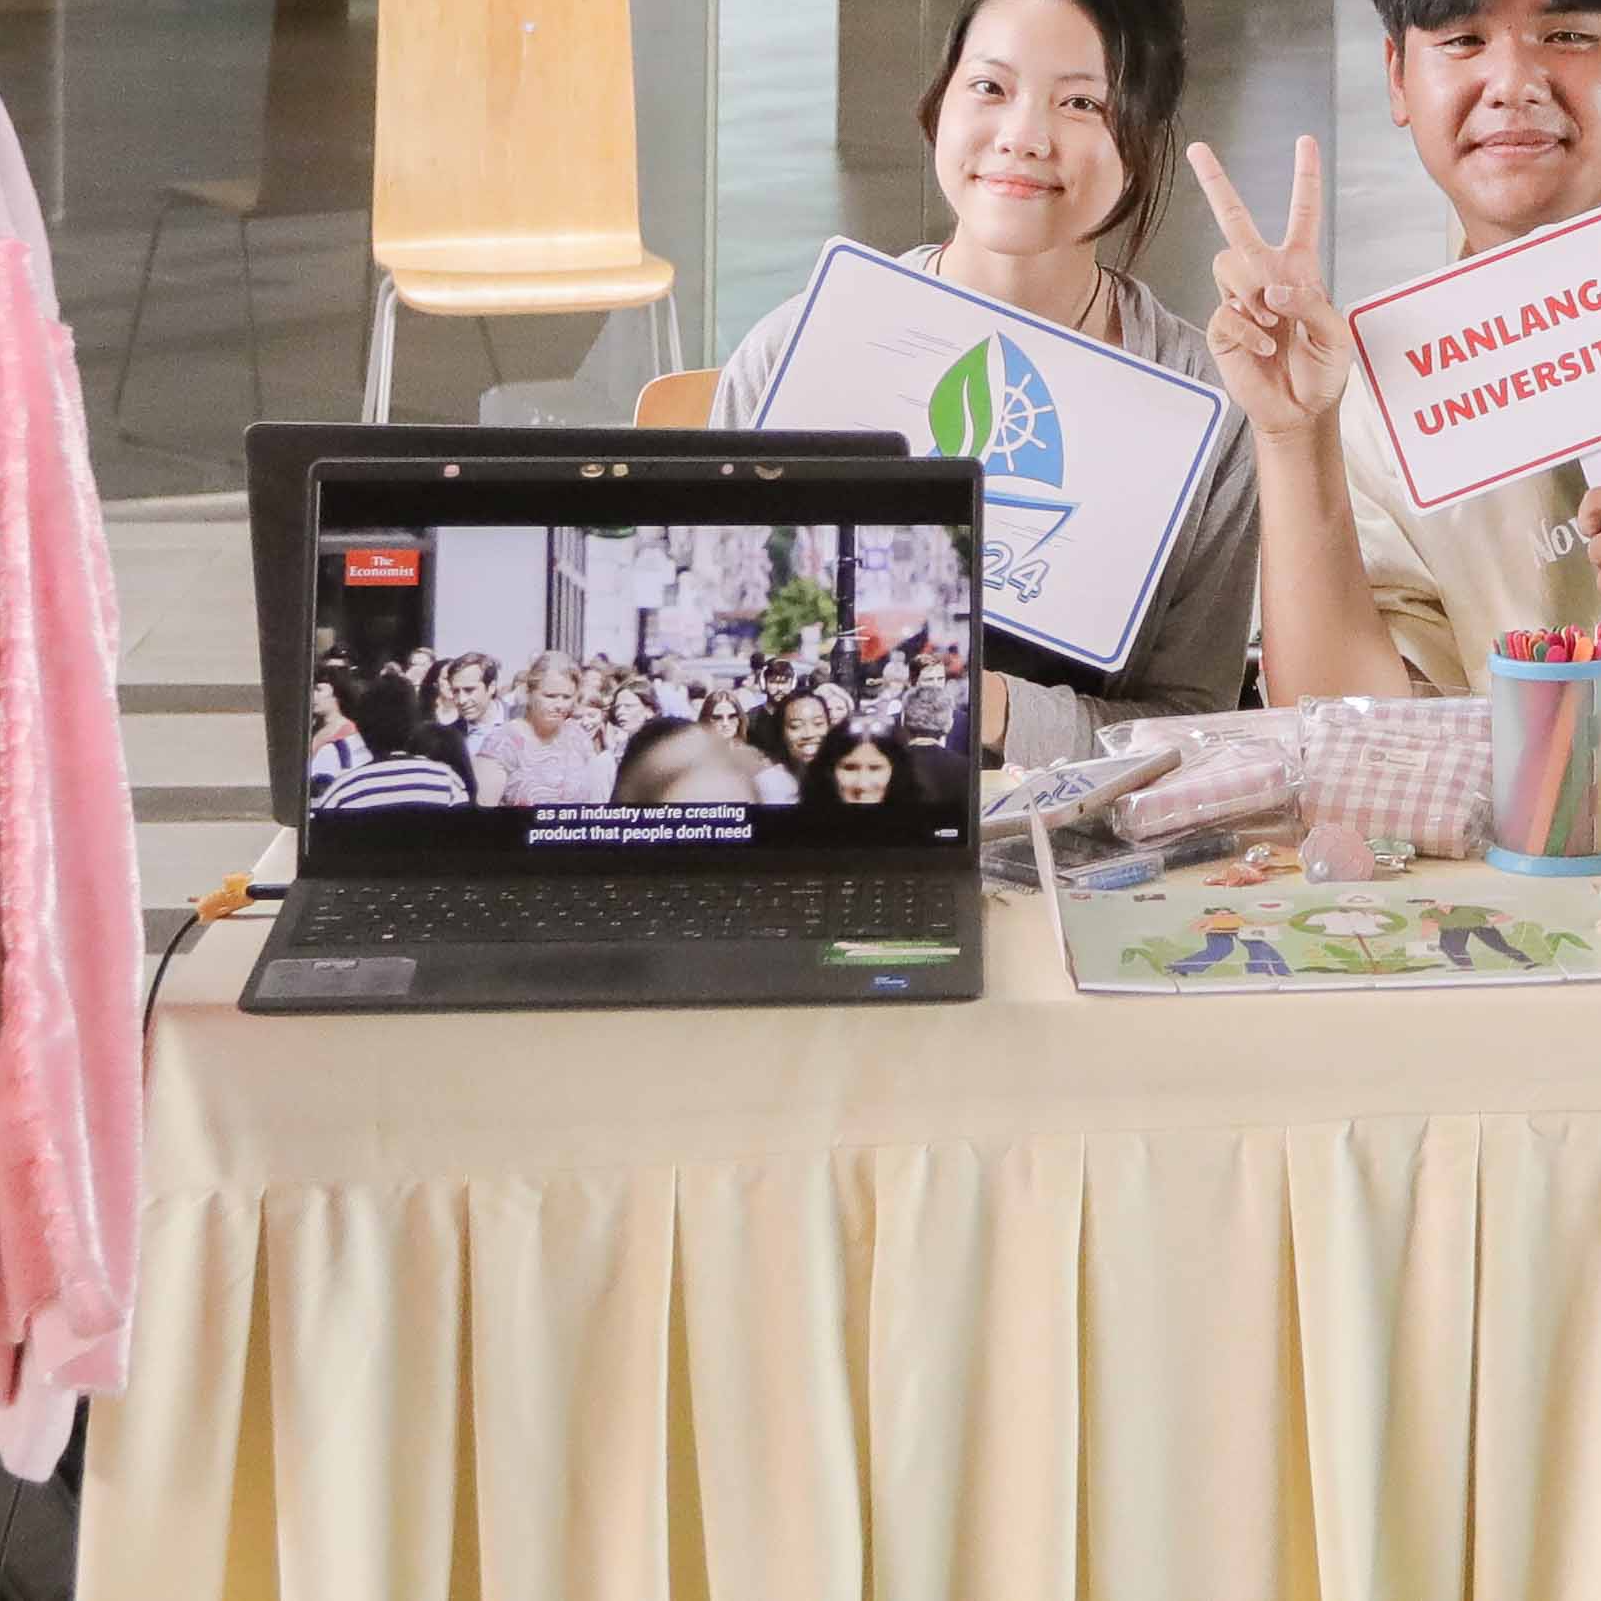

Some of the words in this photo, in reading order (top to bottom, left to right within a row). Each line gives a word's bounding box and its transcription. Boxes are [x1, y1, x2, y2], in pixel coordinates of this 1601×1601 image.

[349, 565, 415, 577] Economist
[370, 555, 395, 567] The
[982, 540, 1051, 603] 24
[536, 808, 555, 821] as
[558, 808, 577, 821] an
[580, 805, 641, 824] industry
[643, 805, 682, 820] we're
[685, 804, 746, 823] creating
[528, 826, 587, 844] product
[589, 825, 620, 840] that
[622, 825, 674, 844] people
[675, 824, 712, 840] don't
[714, 823, 752, 839] need
